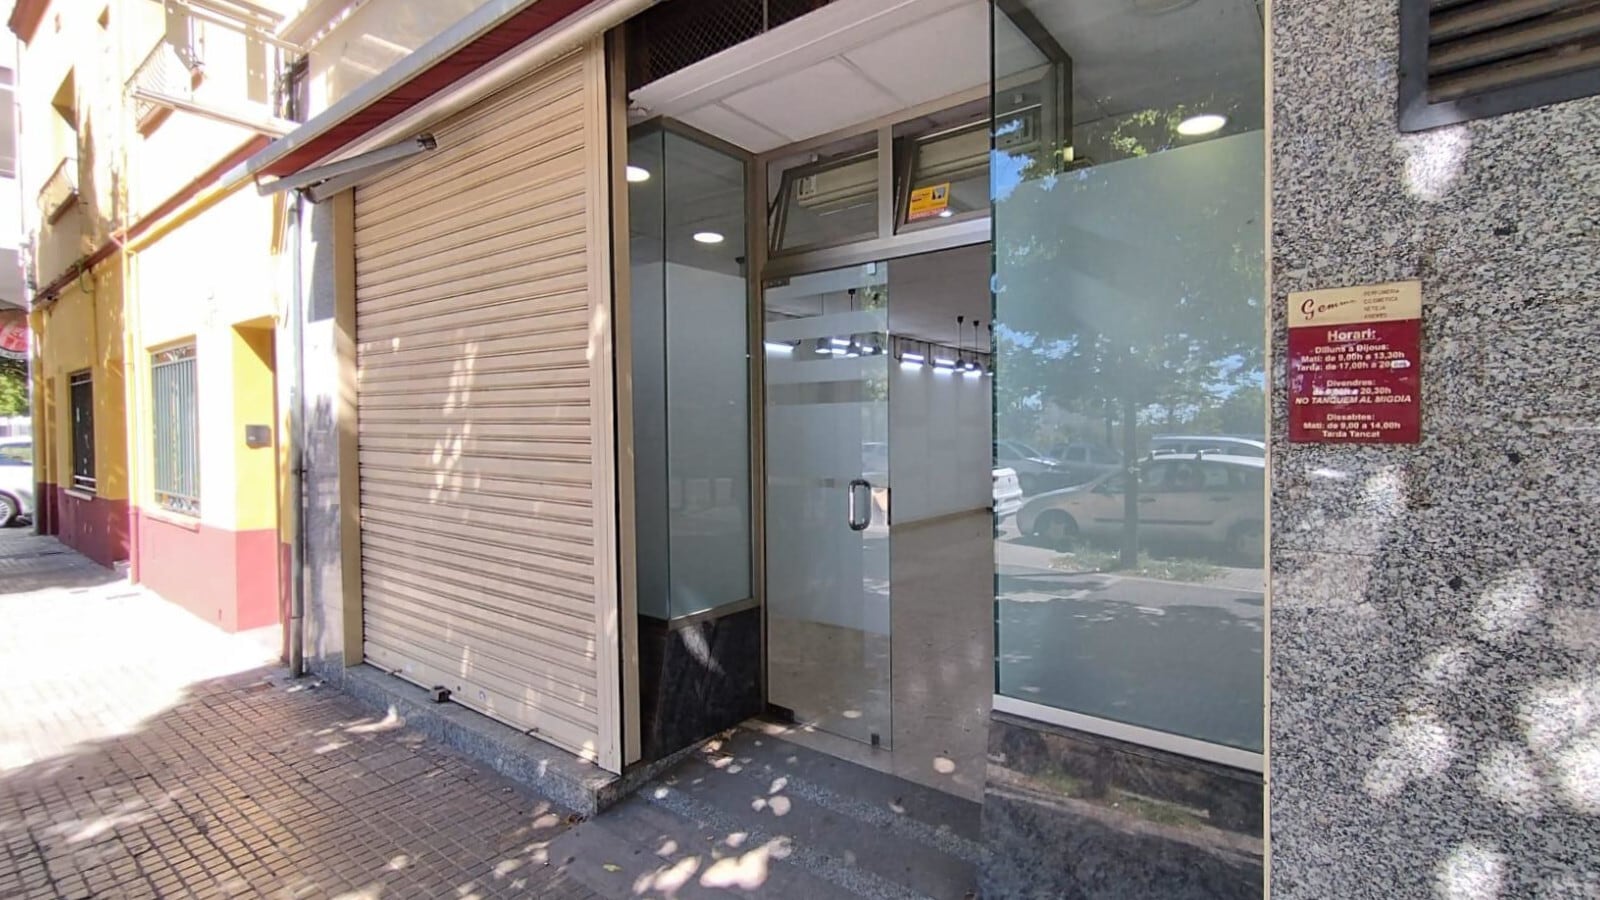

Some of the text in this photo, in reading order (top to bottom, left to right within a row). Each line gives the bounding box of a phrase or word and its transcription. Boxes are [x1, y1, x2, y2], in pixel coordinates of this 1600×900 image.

[1327, 328, 1376, 341] Horari:
[1315, 346, 1345, 354] Dilluns
[1340, 361, 1368, 369] 17,00h
